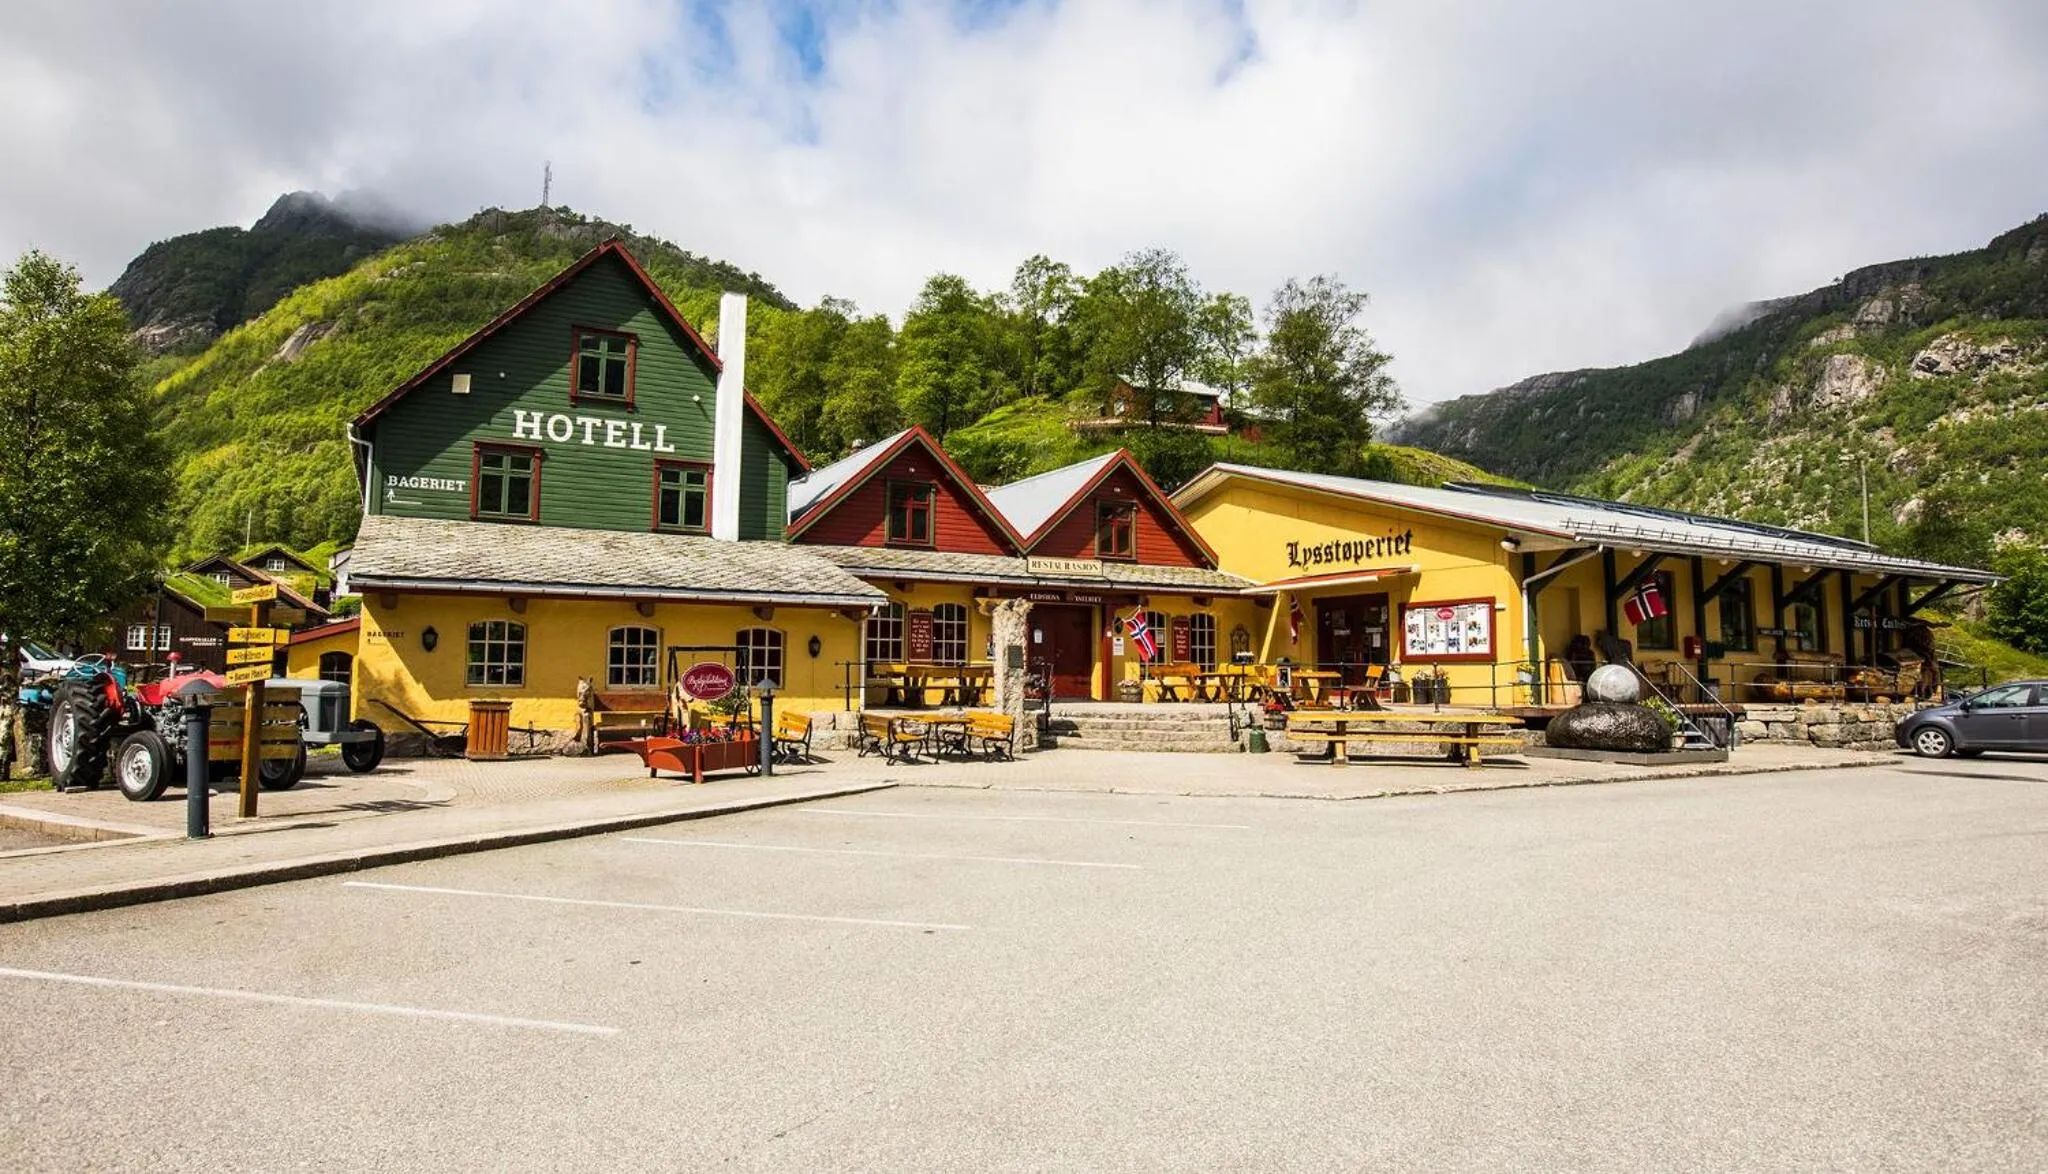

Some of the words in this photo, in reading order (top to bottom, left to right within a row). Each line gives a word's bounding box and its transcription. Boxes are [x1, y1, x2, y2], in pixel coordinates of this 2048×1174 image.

[512, 410, 675, 453] HOTELL
[387, 475, 466, 492] BAGERIET
[1286, 527, 1413, 572] Lysstøperiet
[1031, 560, 1098, 571] RESTAURASJON
